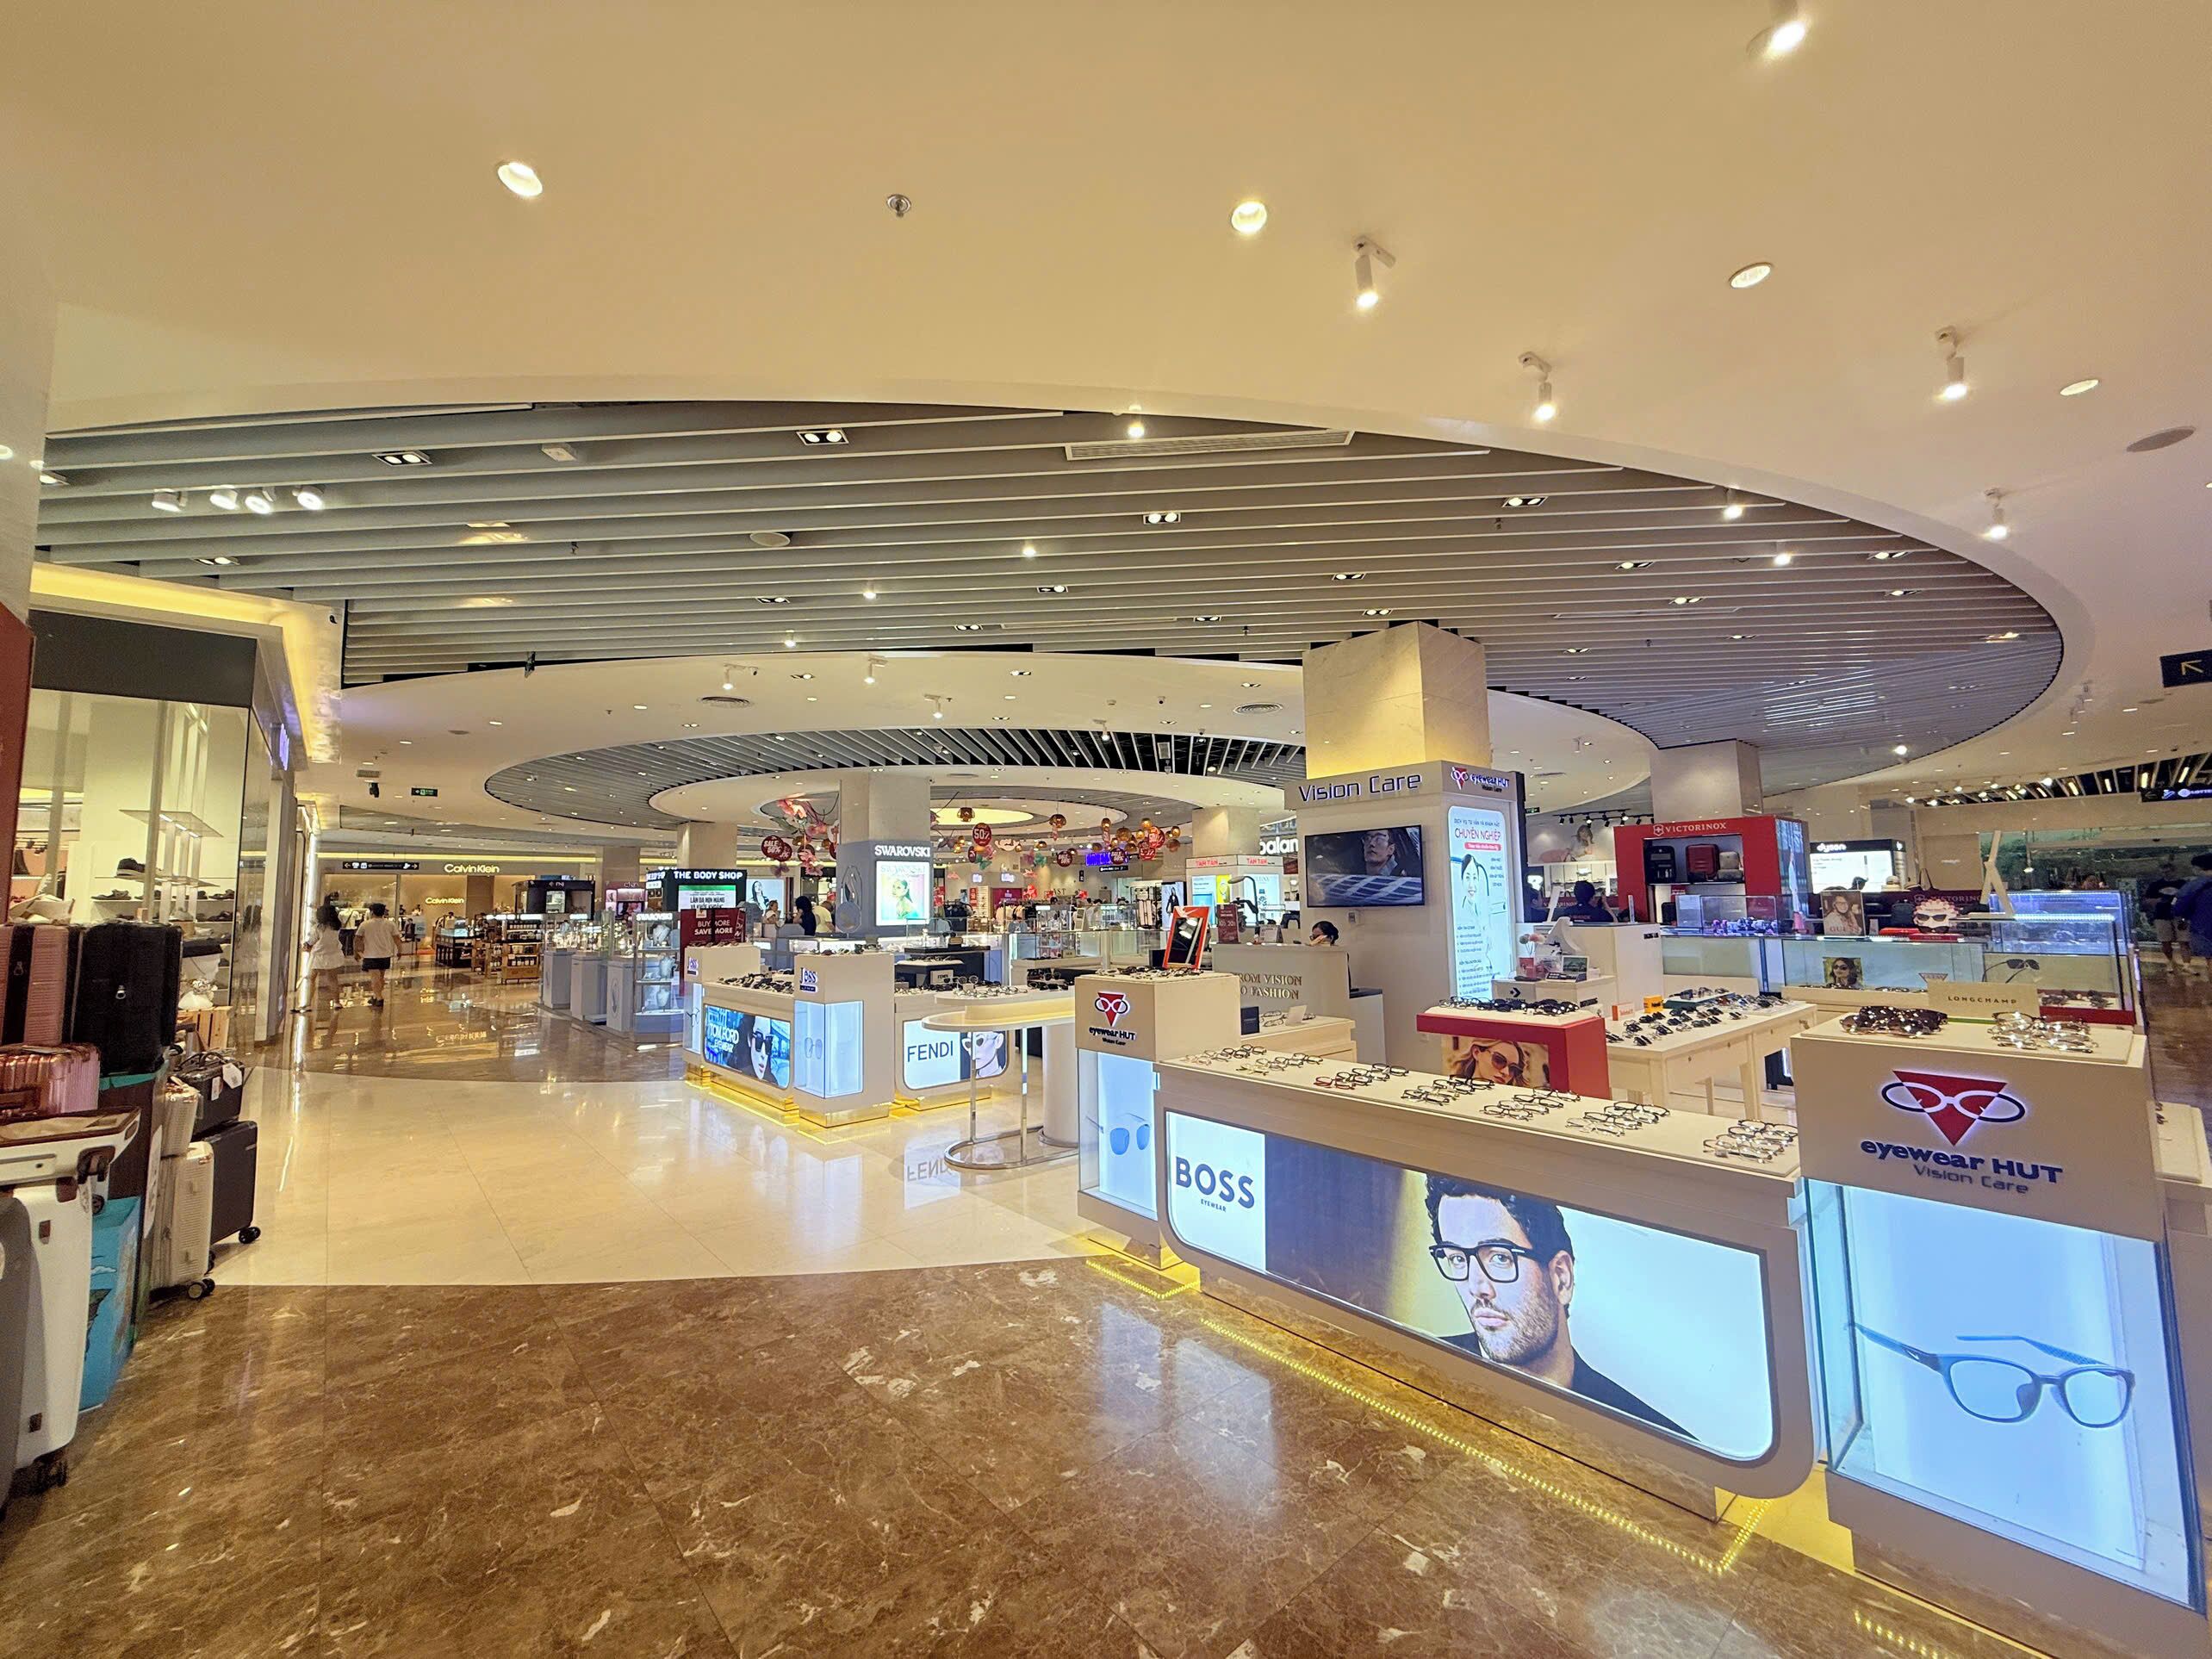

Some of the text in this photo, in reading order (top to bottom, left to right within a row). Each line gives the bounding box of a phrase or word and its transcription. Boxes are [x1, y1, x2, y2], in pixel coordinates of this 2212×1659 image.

[1298, 774, 1421, 802] Vision Care
[1665, 822, 1726, 833] VICTORINOX
[874, 845, 930, 857] SWAROVSKI
[1817, 843, 1847, 852] dyson
[444, 864, 500, 873] Calvin Klein
[799, 966, 817, 983] Jess
[1264, 974, 1302, 985] VISION
[1251, 986, 1299, 999] FASHION
[1089, 1027, 1136, 1040] eyewear HUT
[907, 1041, 954, 1062] FENDI
[1861, 1140, 2064, 1184] eyewear HUT
[1175, 1156, 1255, 1209] BOSS
[1913, 1164, 2029, 1194] Vision Care
[1201, 1198, 1227, 1213] EYEWEAR
